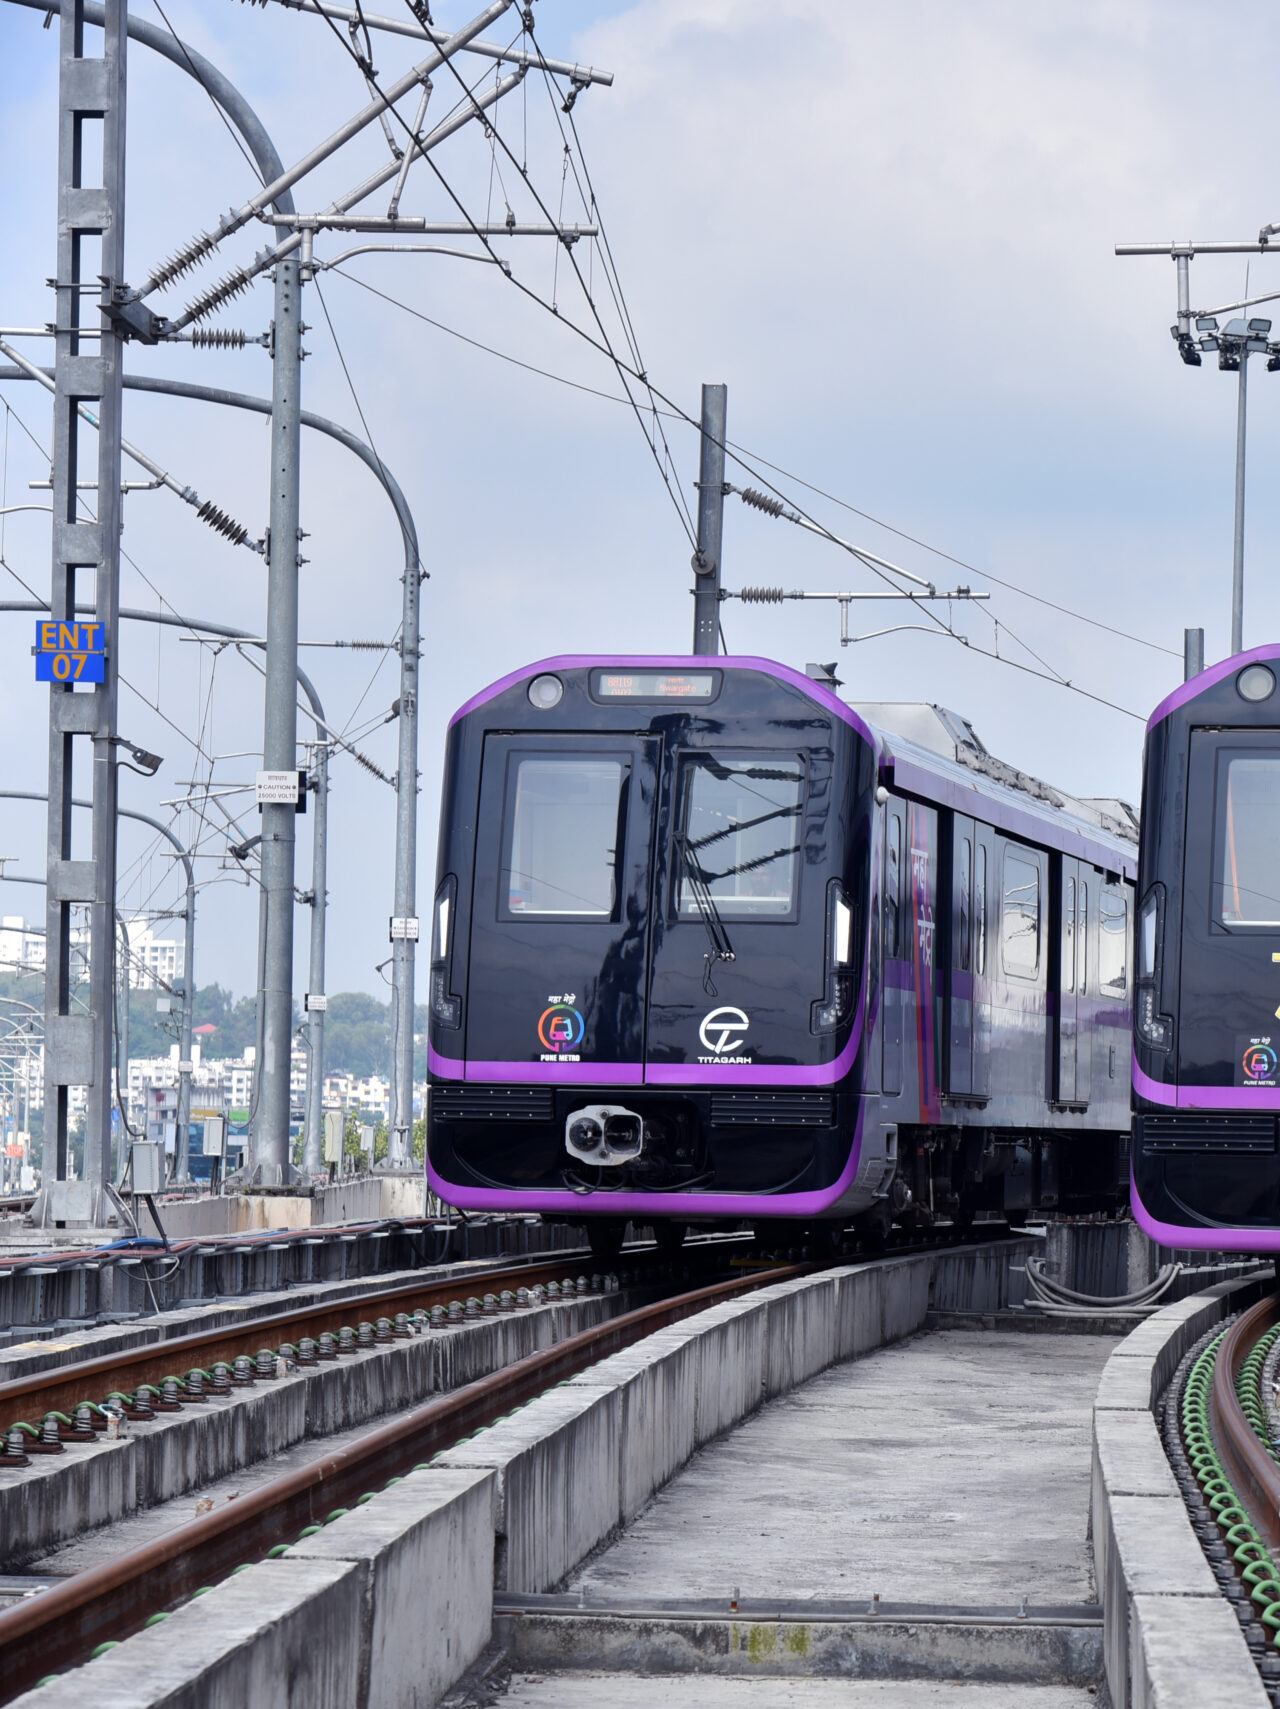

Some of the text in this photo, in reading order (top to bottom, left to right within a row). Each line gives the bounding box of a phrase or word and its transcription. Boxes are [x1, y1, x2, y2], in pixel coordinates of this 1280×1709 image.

[42, 623, 100, 649] ENT
[53, 654, 88, 679] 07
[540, 1054, 580, 1062] PUNE METRO
[697, 1056, 751, 1064] TITAGARH
